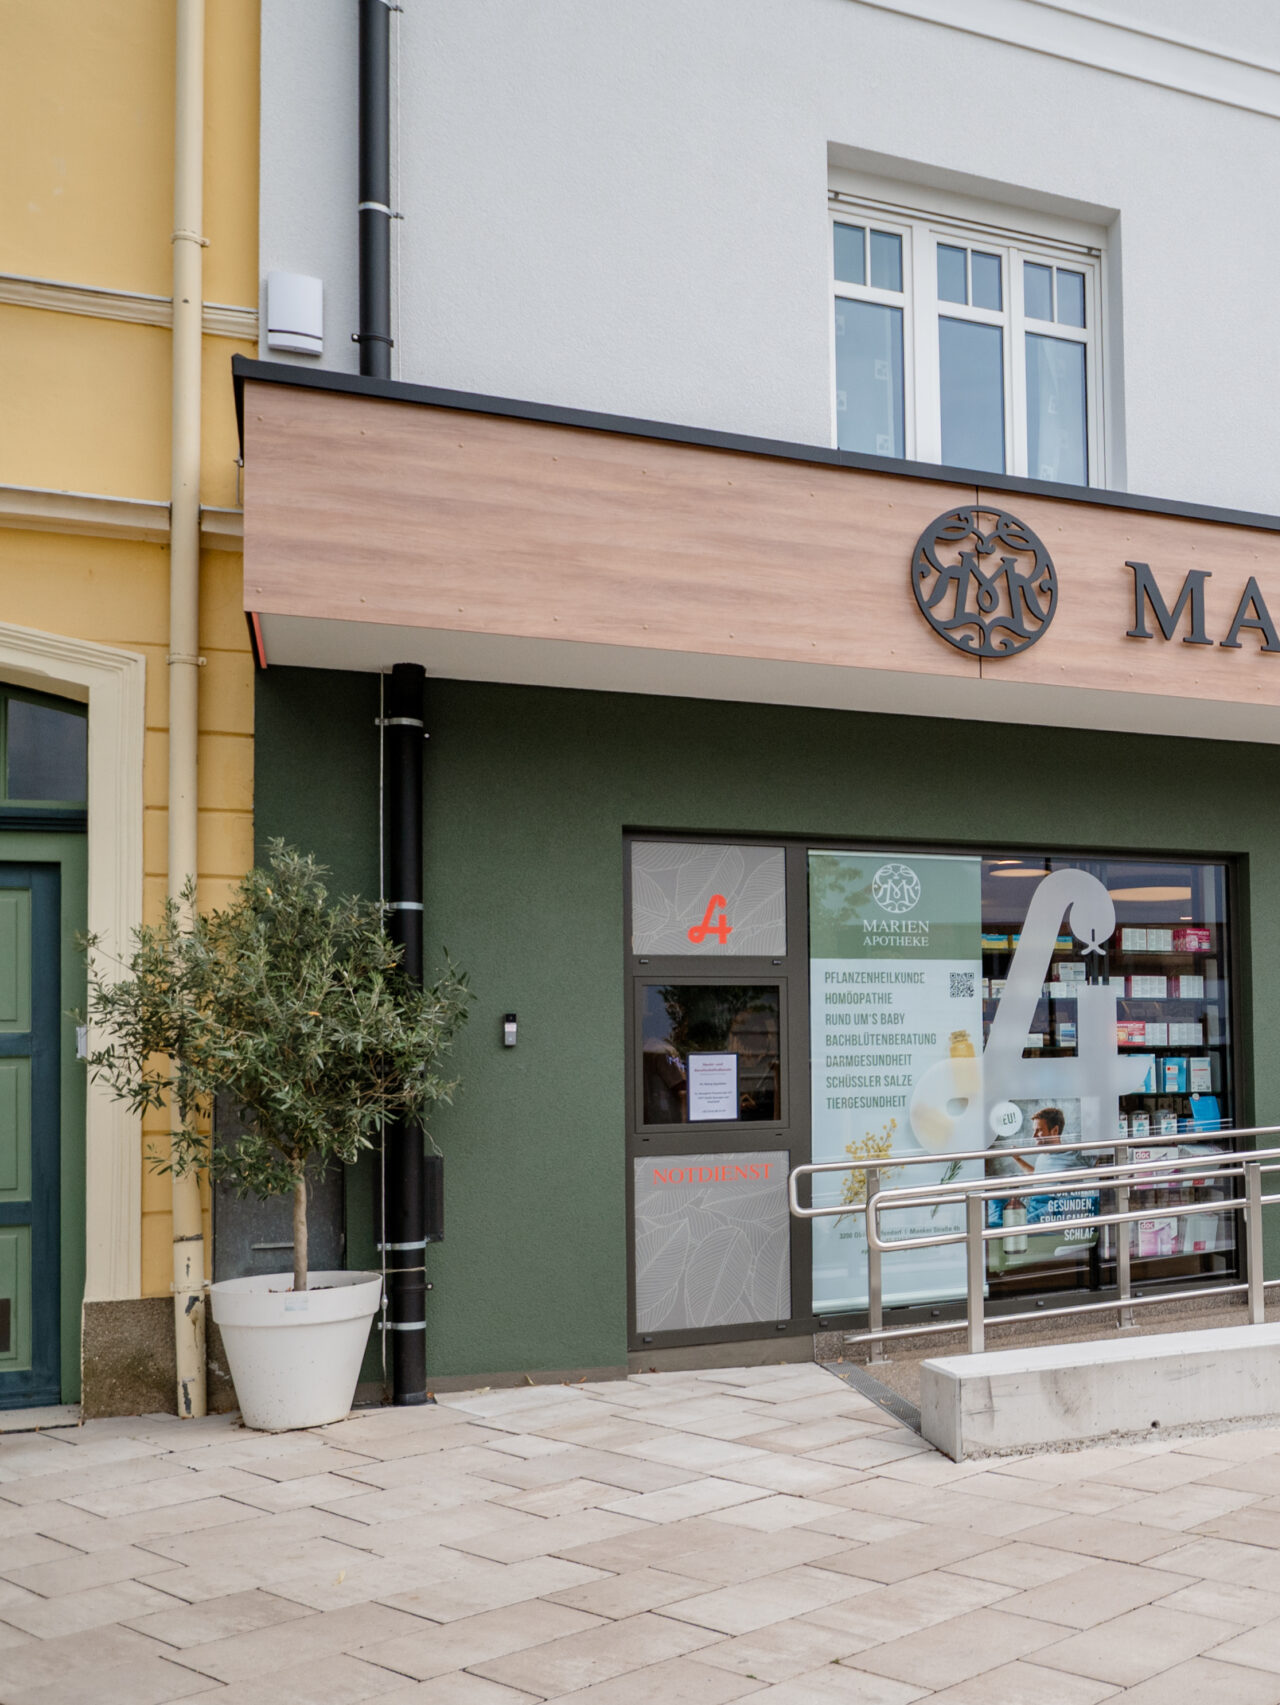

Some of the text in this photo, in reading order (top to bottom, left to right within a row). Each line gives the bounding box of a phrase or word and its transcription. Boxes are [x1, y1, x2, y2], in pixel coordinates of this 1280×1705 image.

[862, 920, 929, 933] MARIEN
[862, 935, 929, 947] APOTHEKE
[825, 972, 925, 984] PFLANZENHEILKUNDE
[825, 991, 893, 1005] HOMÖOPATHIE
[825, 1013, 851, 1026] RUND
[881, 1013, 905, 1025] BABY
[826, 1032, 936, 1046] BACHBLÜTENBERATUNG
[826, 1054, 912, 1067] DARMGESUNDHEIT
[826, 1074, 912, 1088] SCHÜSSLER SALZE
[827, 1095, 907, 1110] TIERGESUNDHEIT
[653, 1163, 775, 1185] NOTDIENST
[1048, 1198, 1094, 1212] GESUNDEN,
[1064, 1227, 1095, 1241] SCHLAF
